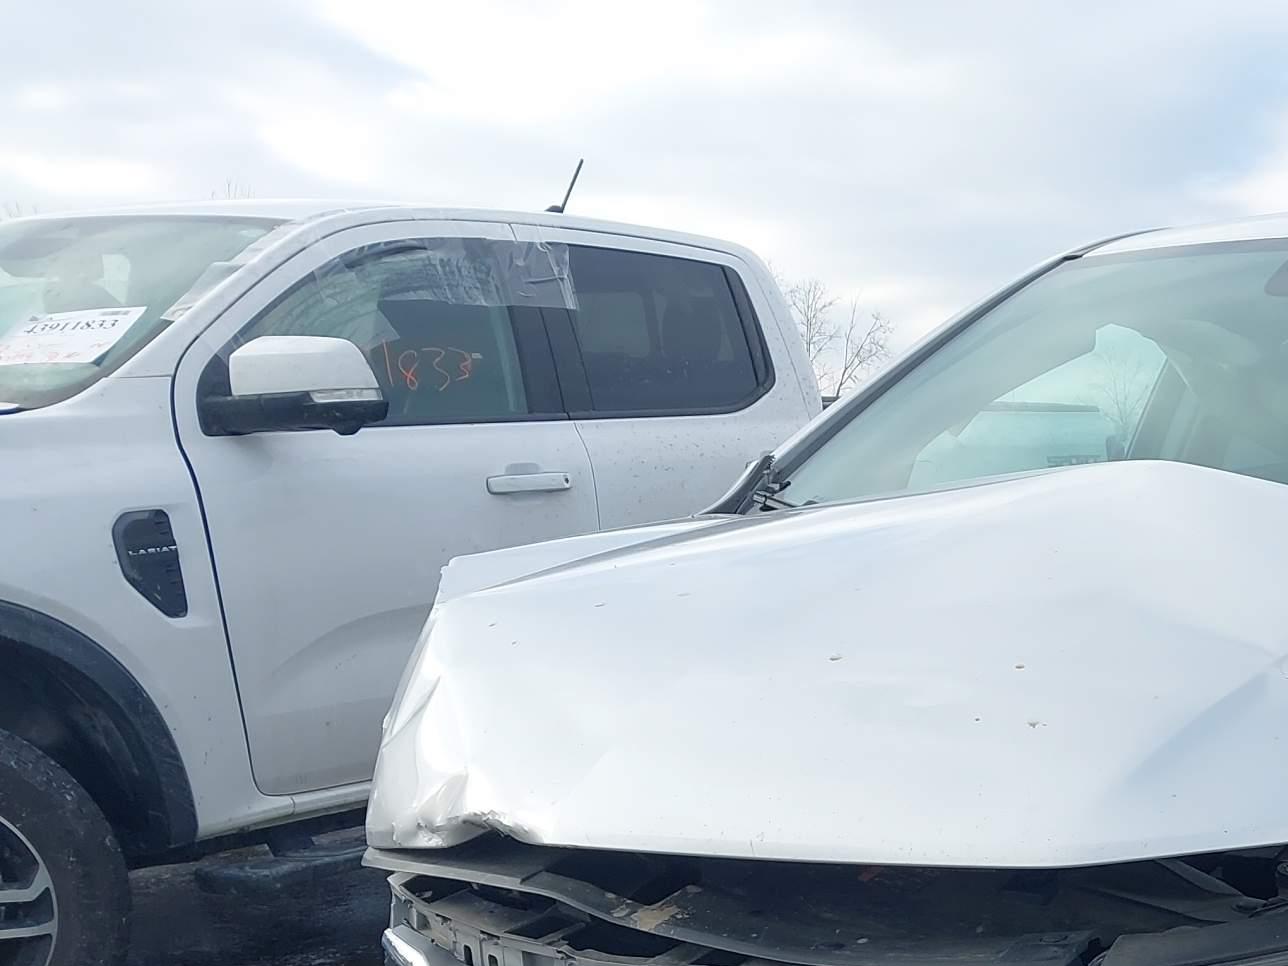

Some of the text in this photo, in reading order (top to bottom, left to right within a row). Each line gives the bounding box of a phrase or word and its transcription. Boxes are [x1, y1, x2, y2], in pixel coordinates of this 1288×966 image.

[24, 319, 119, 334] 43911833
[383, 341, 473, 391] 1833
[128, 545, 177, 556] LARIAT
